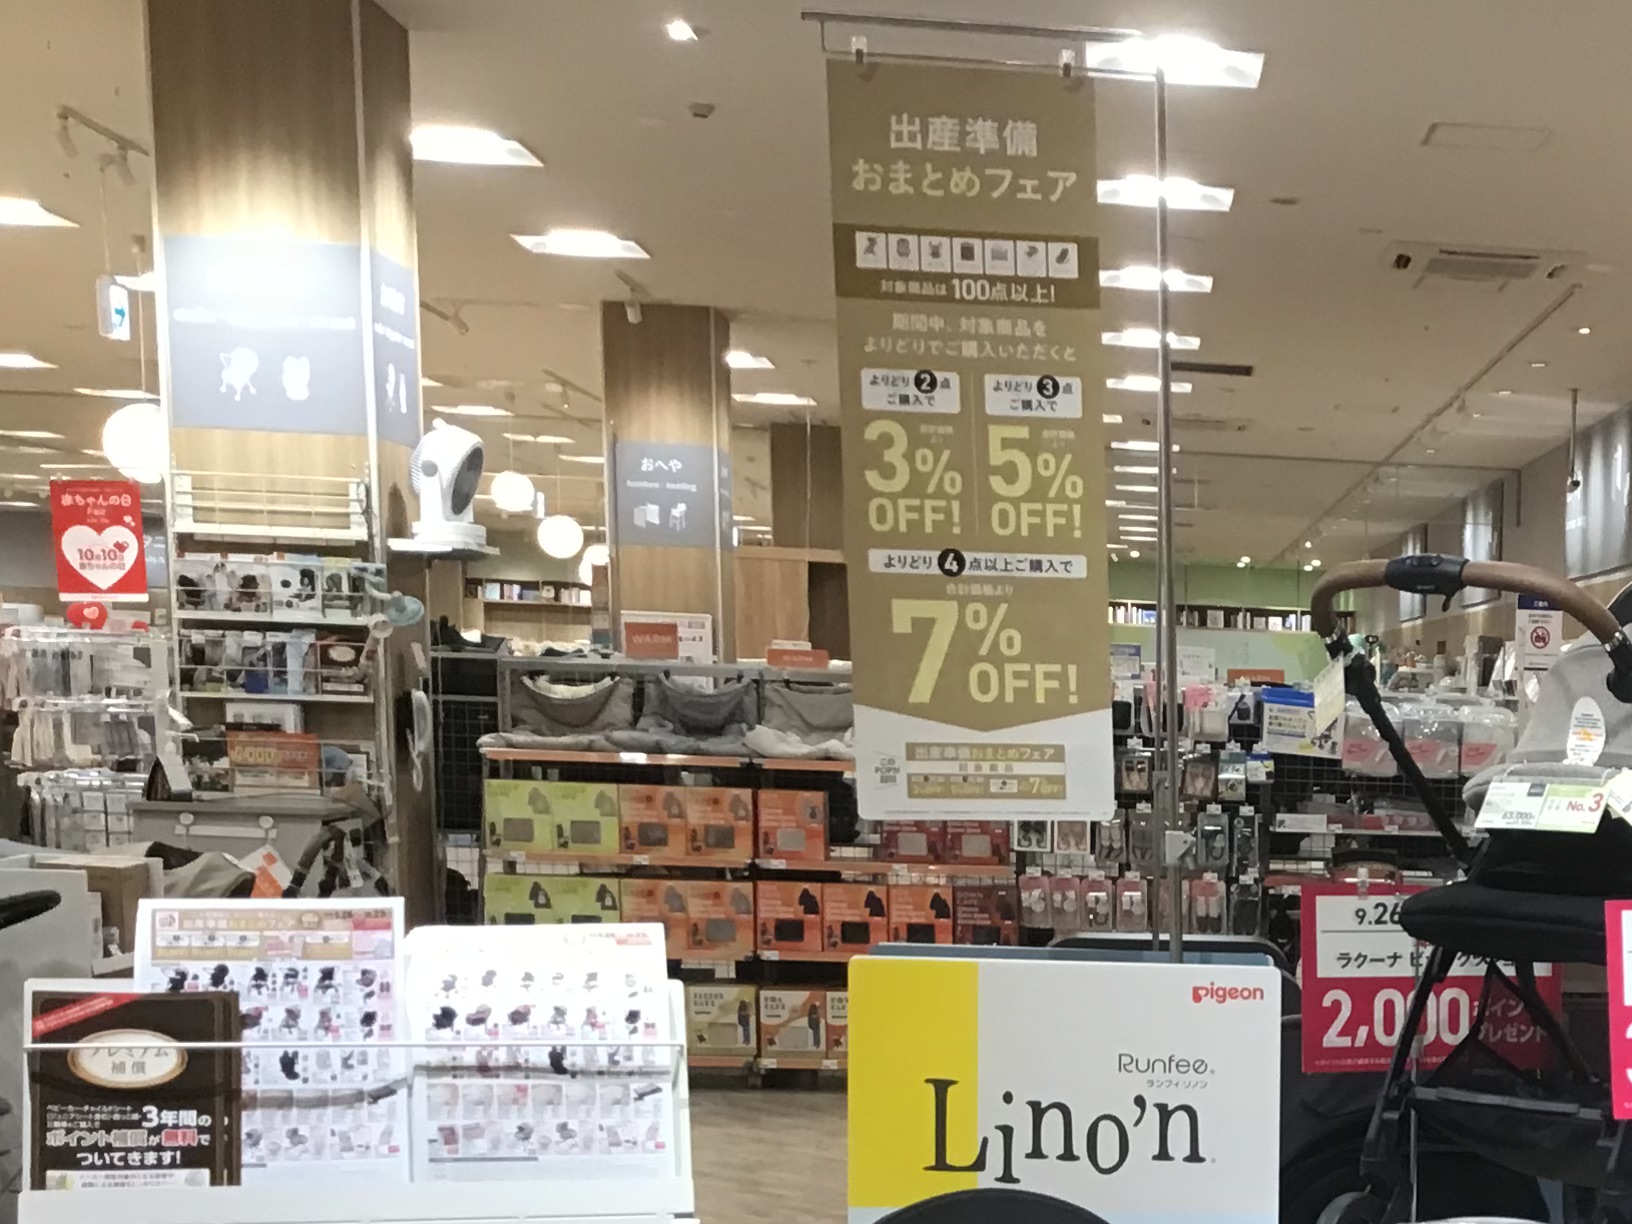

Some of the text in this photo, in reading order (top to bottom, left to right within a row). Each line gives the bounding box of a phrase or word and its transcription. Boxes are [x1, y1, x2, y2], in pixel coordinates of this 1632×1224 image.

[890, 114, 1037, 156] 出産準備
[852, 159, 1076, 201] おまとめフェア
[892, 313, 1046, 337] 期間中、対象商品を
[864, 337, 1077, 361] よりどりでご購入いただくと
[640, 457, 683, 473] おへや
[61, 493, 132, 507] 赤ちゃんの日
[868, 498, 962, 534] OFF!
[990, 502, 1082, 538] OFF!
[969, 663, 1078, 704] OFF!
[1565, 793, 1604, 814] No.3
[1336, 952, 1403, 969] ラクーナ
[1192, 982, 1265, 1004] pigeon
[1321, 987, 1471, 1048] 2,000
[111, 1060, 147, 1074] 補償
[1117, 1053, 1210, 1076] Runfee
[141, 1104, 212, 1128] 3年間の
[922, 1077, 1208, 1185] Lino'n
[76, 1150, 182, 1166] ついてきます!
